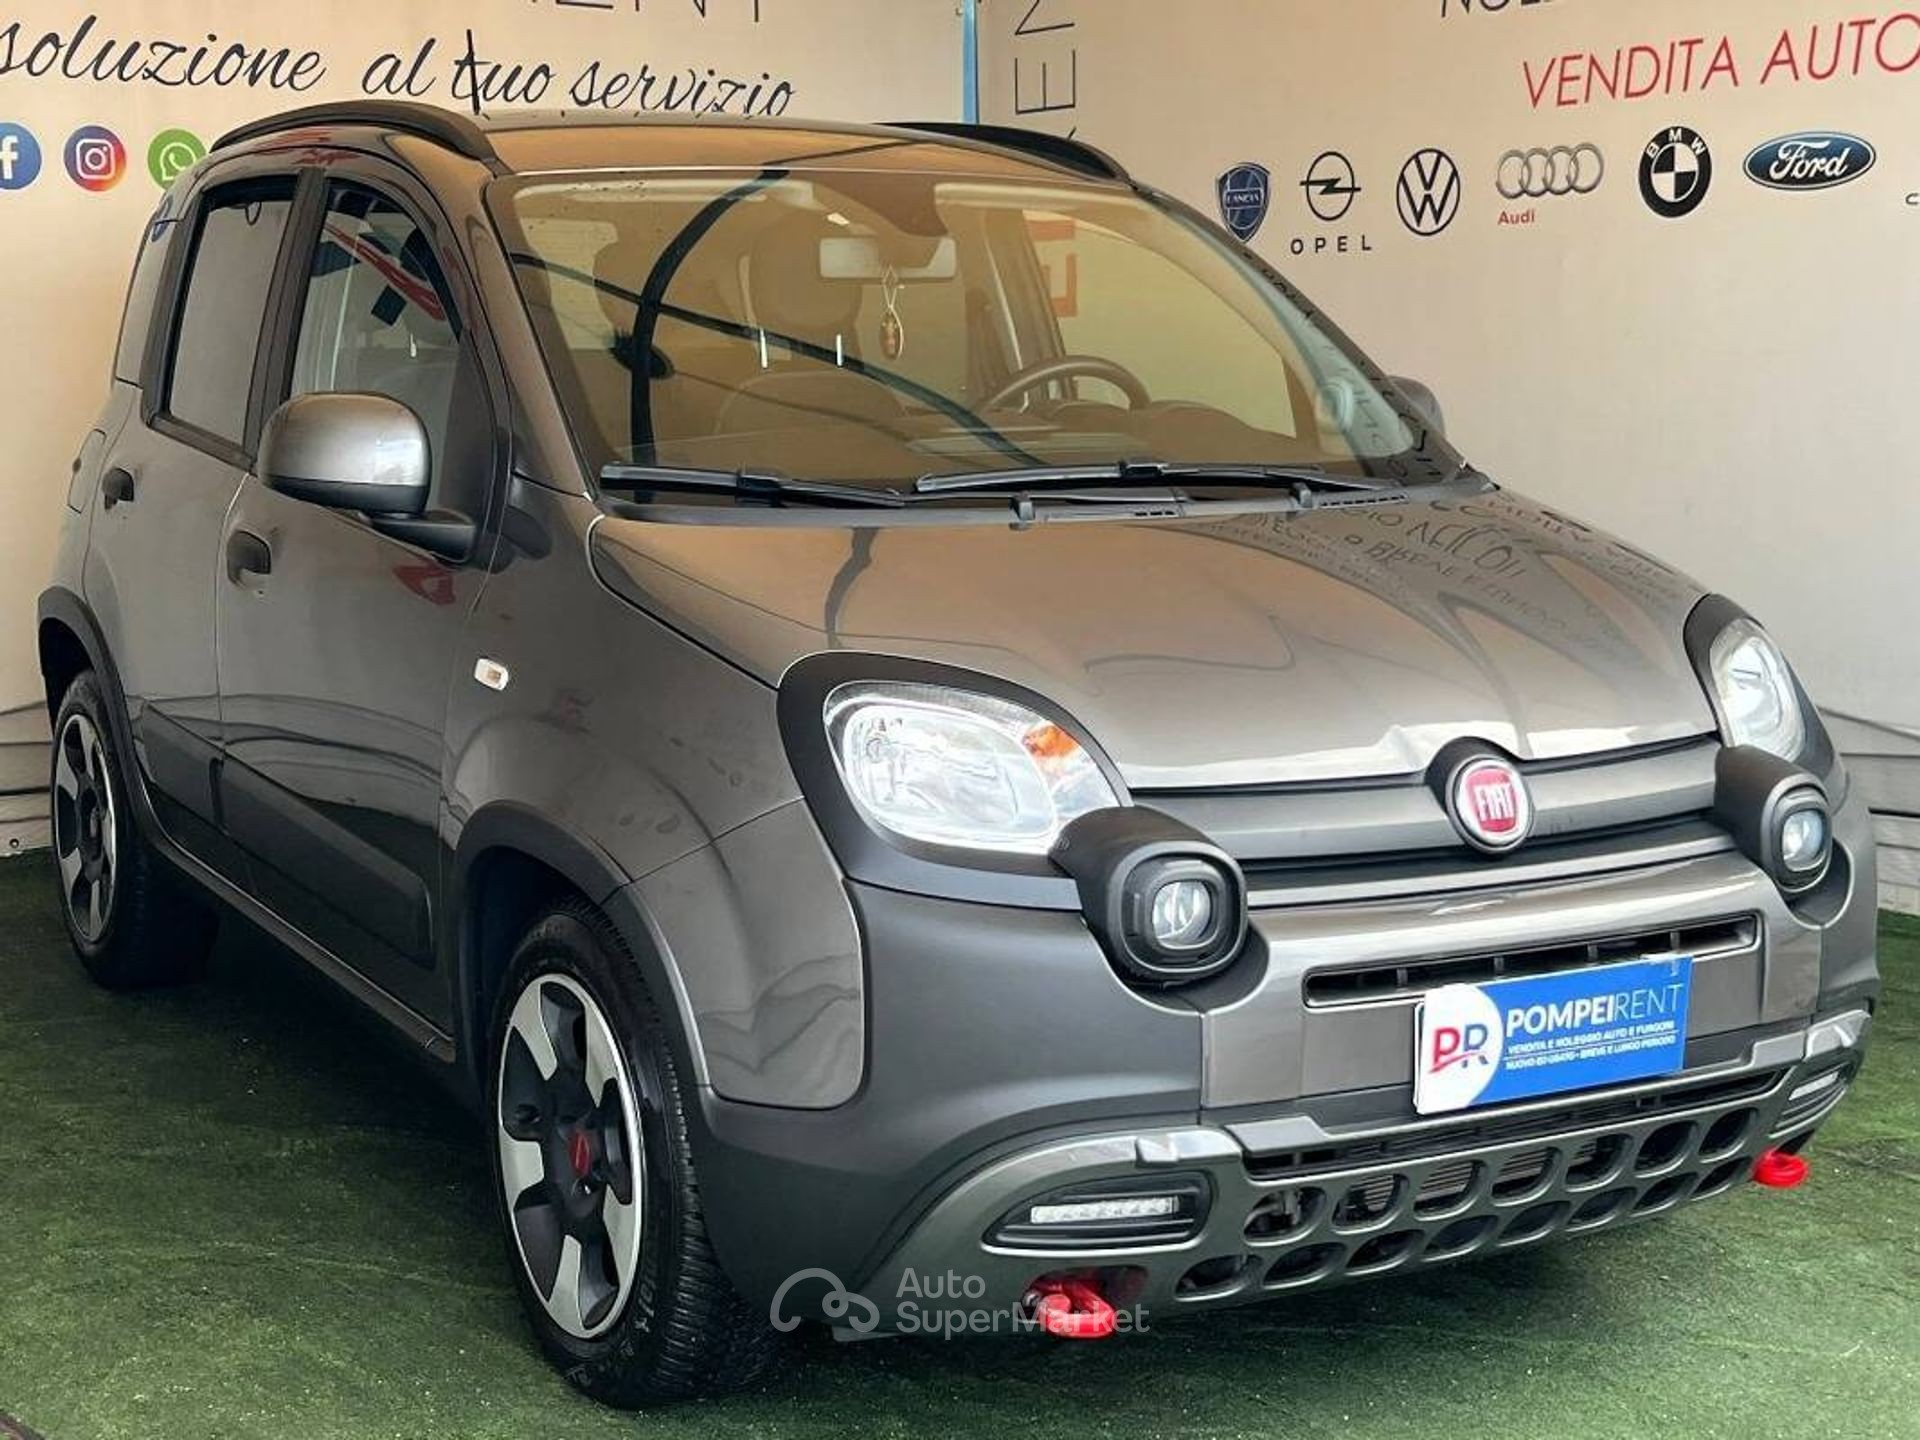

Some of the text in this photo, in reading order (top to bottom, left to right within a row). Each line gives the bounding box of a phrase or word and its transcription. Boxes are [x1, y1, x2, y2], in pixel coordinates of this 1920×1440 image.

[0, 15, 797, 116] soluzione al tuo servizio
[1523, 14, 1920, 109] VENDITA AUTO
[1645, 127, 1706, 159] BMW
[1768, 140, 1851, 181] Ford
[1498, 209, 1535, 225] Audi
[1290, 235, 1372, 255] OPEL
[1473, 783, 1515, 822] FIAT
